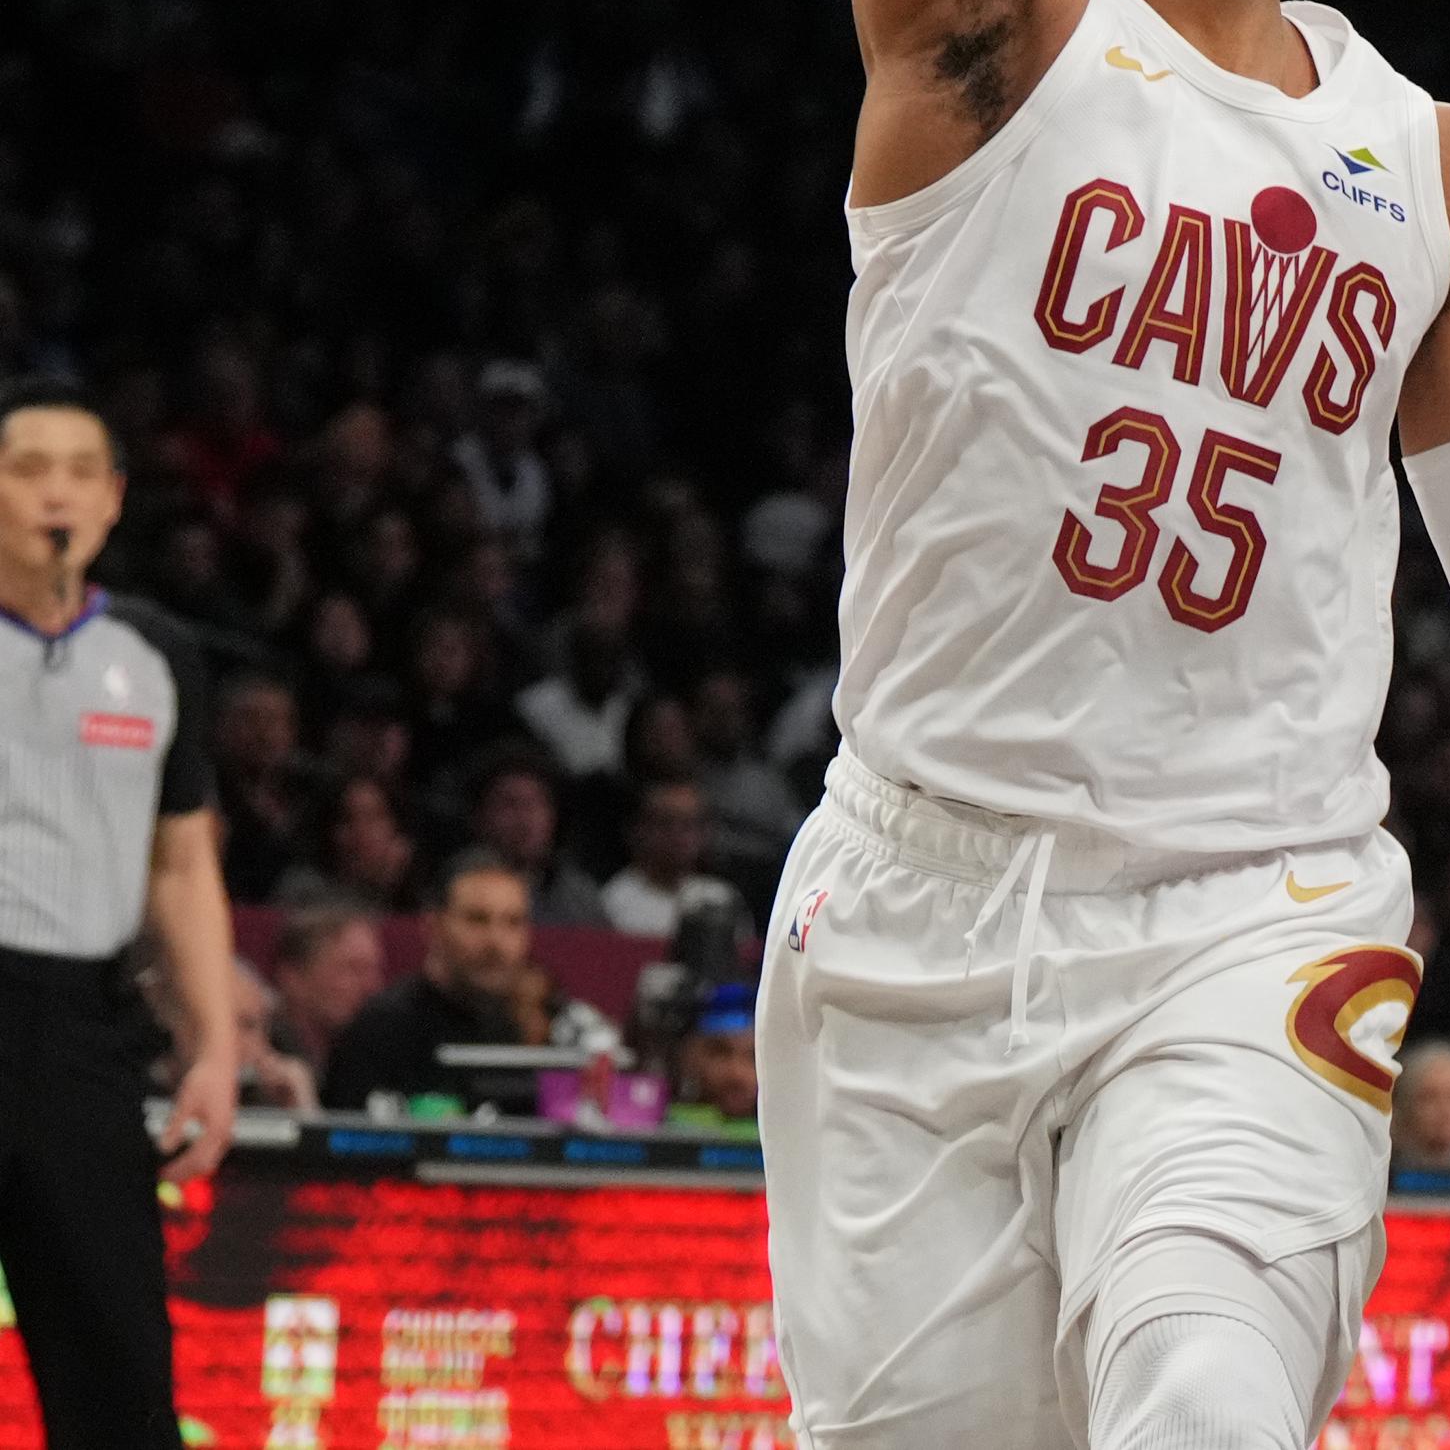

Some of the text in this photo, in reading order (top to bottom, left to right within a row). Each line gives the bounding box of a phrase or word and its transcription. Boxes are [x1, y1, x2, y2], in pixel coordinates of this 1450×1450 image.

[1033, 177, 1397, 435] CAVS
[1322, 170, 1406, 223] CLIFFS
[1052, 405, 1282, 634] 35
